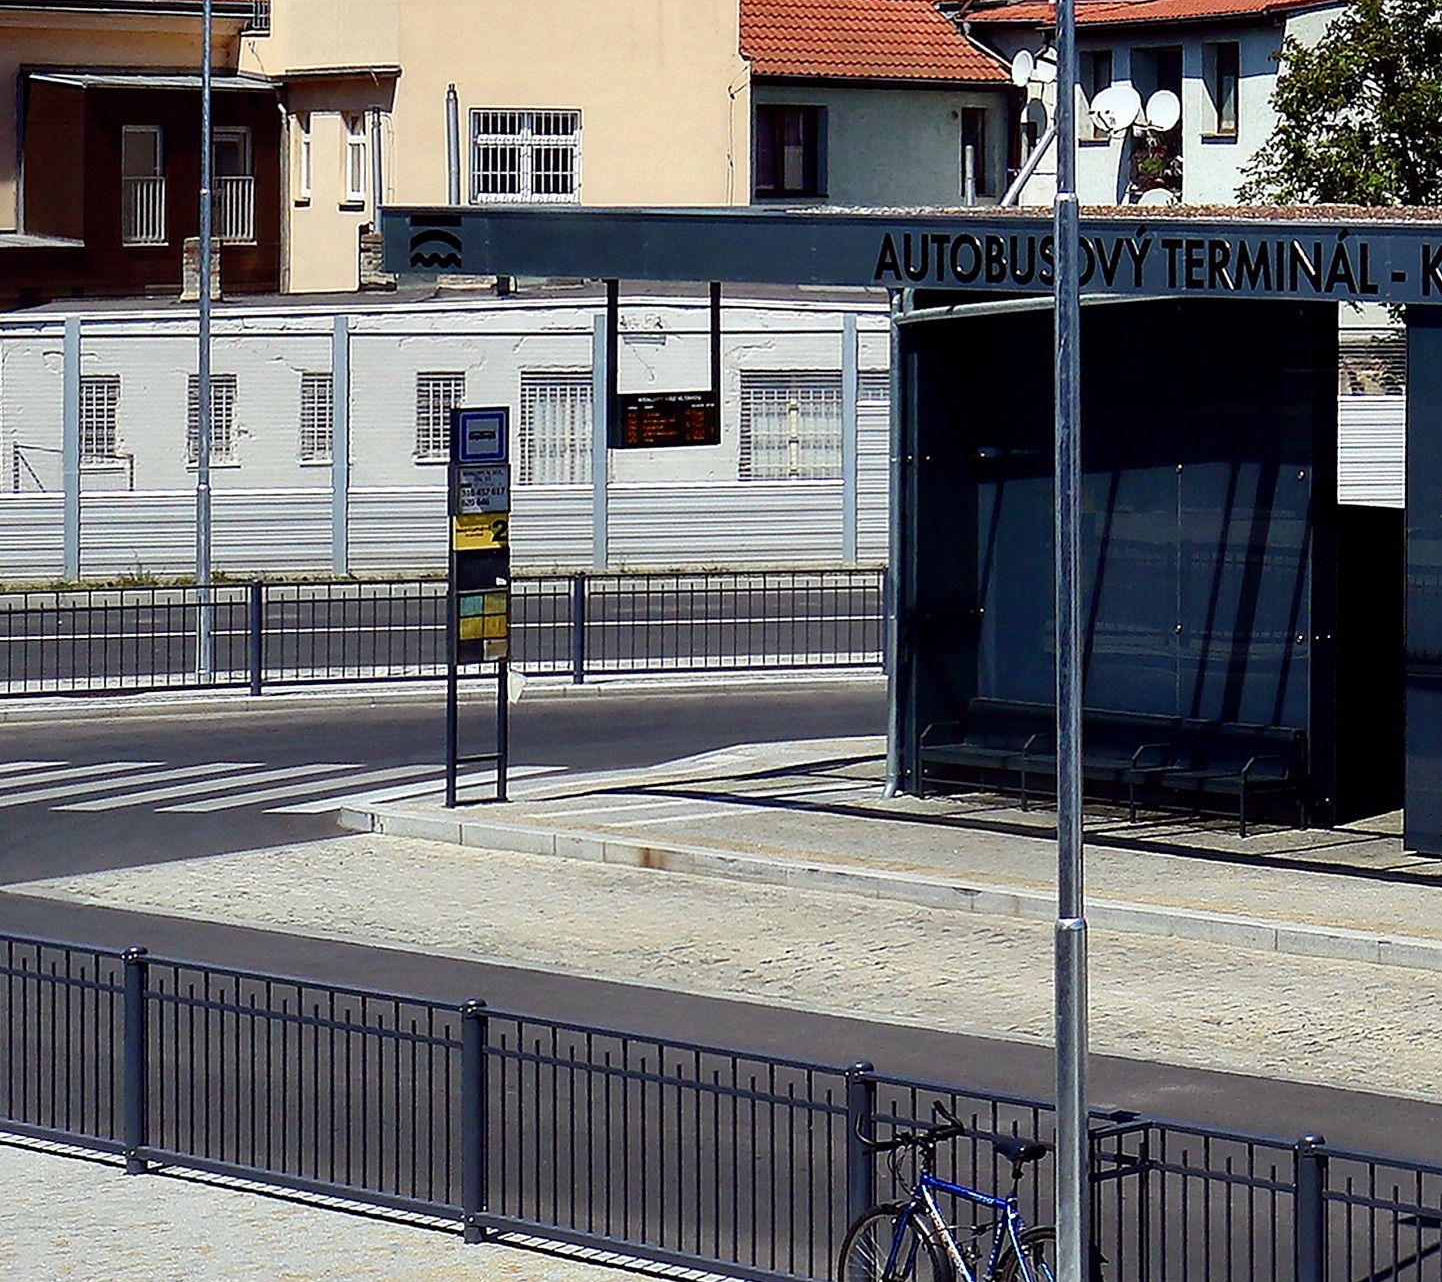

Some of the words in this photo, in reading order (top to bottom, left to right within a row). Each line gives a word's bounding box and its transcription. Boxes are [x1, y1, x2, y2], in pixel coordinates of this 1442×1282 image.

[873, 224, 1150, 288] AUTOBUSOVÝ
[1162, 229, 1378, 295] TERMINÁL
[492, 519, 508, 542] 2
